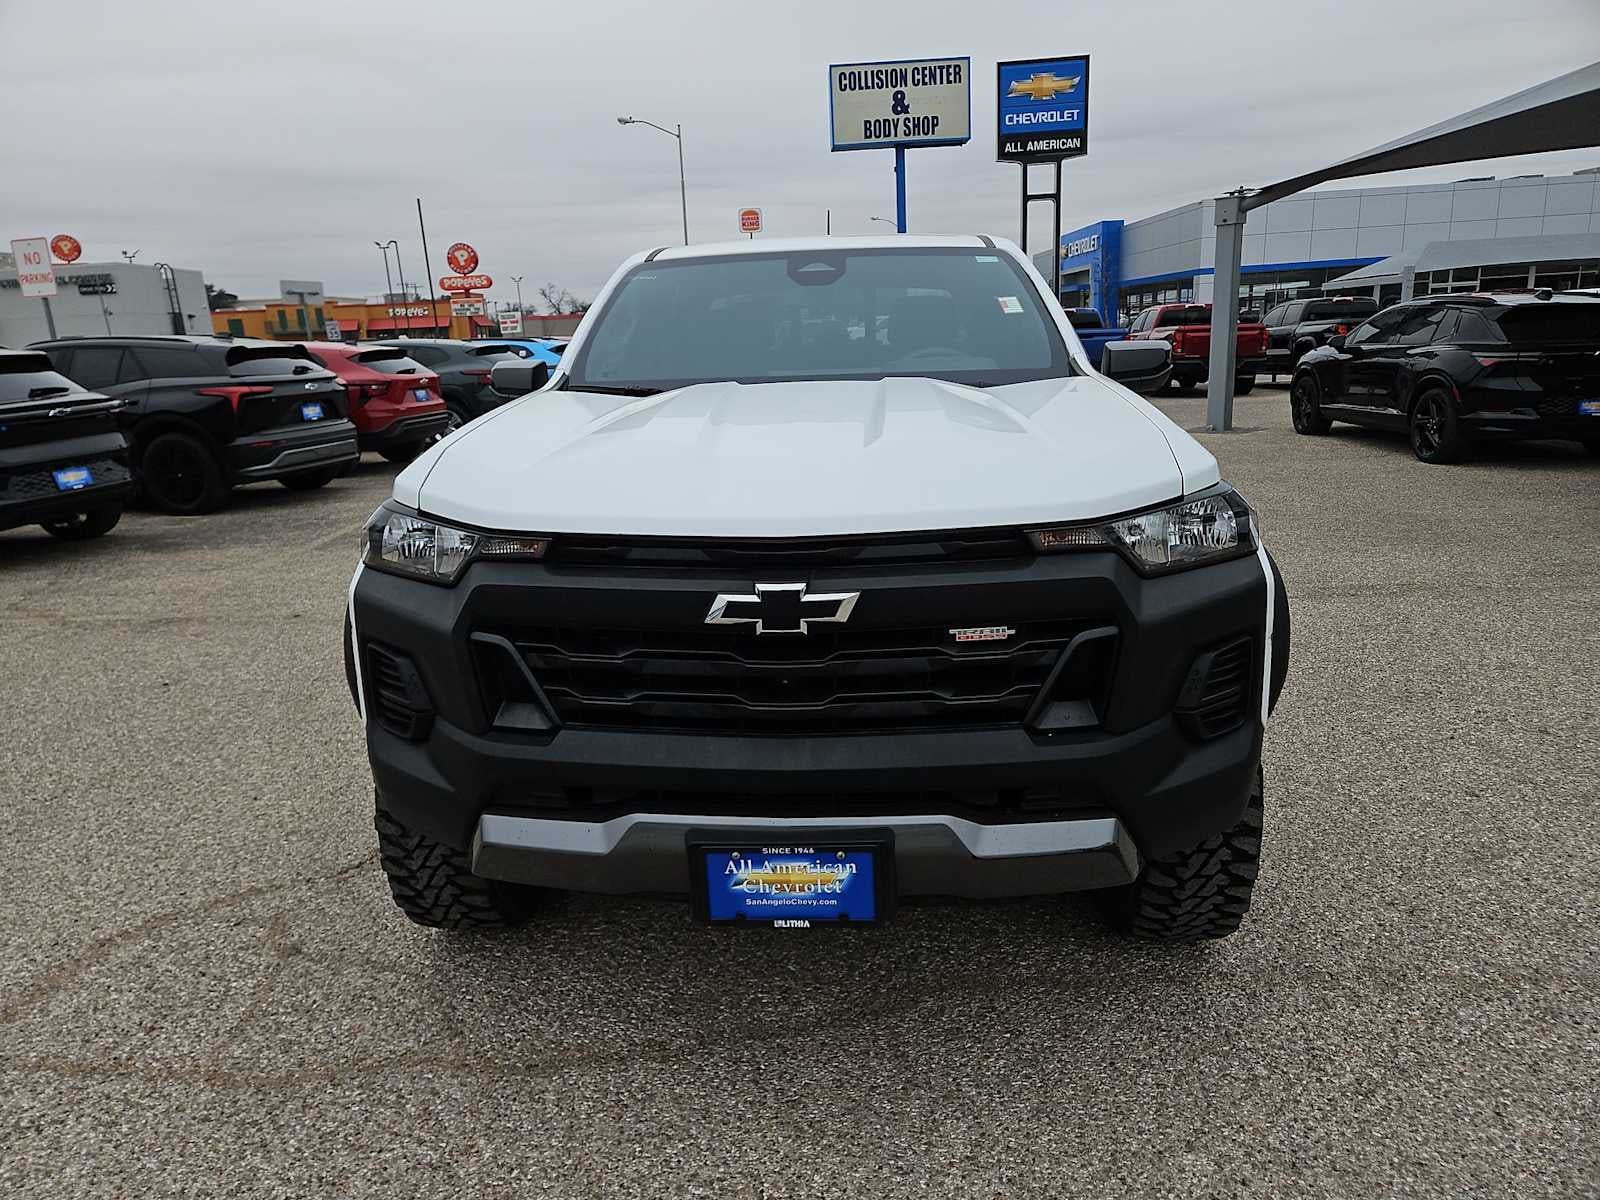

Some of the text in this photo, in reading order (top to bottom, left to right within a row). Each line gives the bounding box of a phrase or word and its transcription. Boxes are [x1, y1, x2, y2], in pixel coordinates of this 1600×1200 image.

[839, 64, 962, 92] COLLISION CENTER
[891, 90, 910, 115] &
[1005, 109, 1080, 125] CHEVROLET
[863, 116, 939, 139] BODY SHOP
[1004, 138, 1081, 153] ALL AMERICAN
[1069, 235, 1099, 257] CHEVROLET
[23, 251, 41, 265] NO
[20, 272, 53, 284] PARKING
[762, 847, 815, 855] SINCE 1946
[724, 860, 857, 874] All American
[742, 879, 842, 894] Chevrolet
[746, 898, 837, 907] SanAngeloChevy.com
